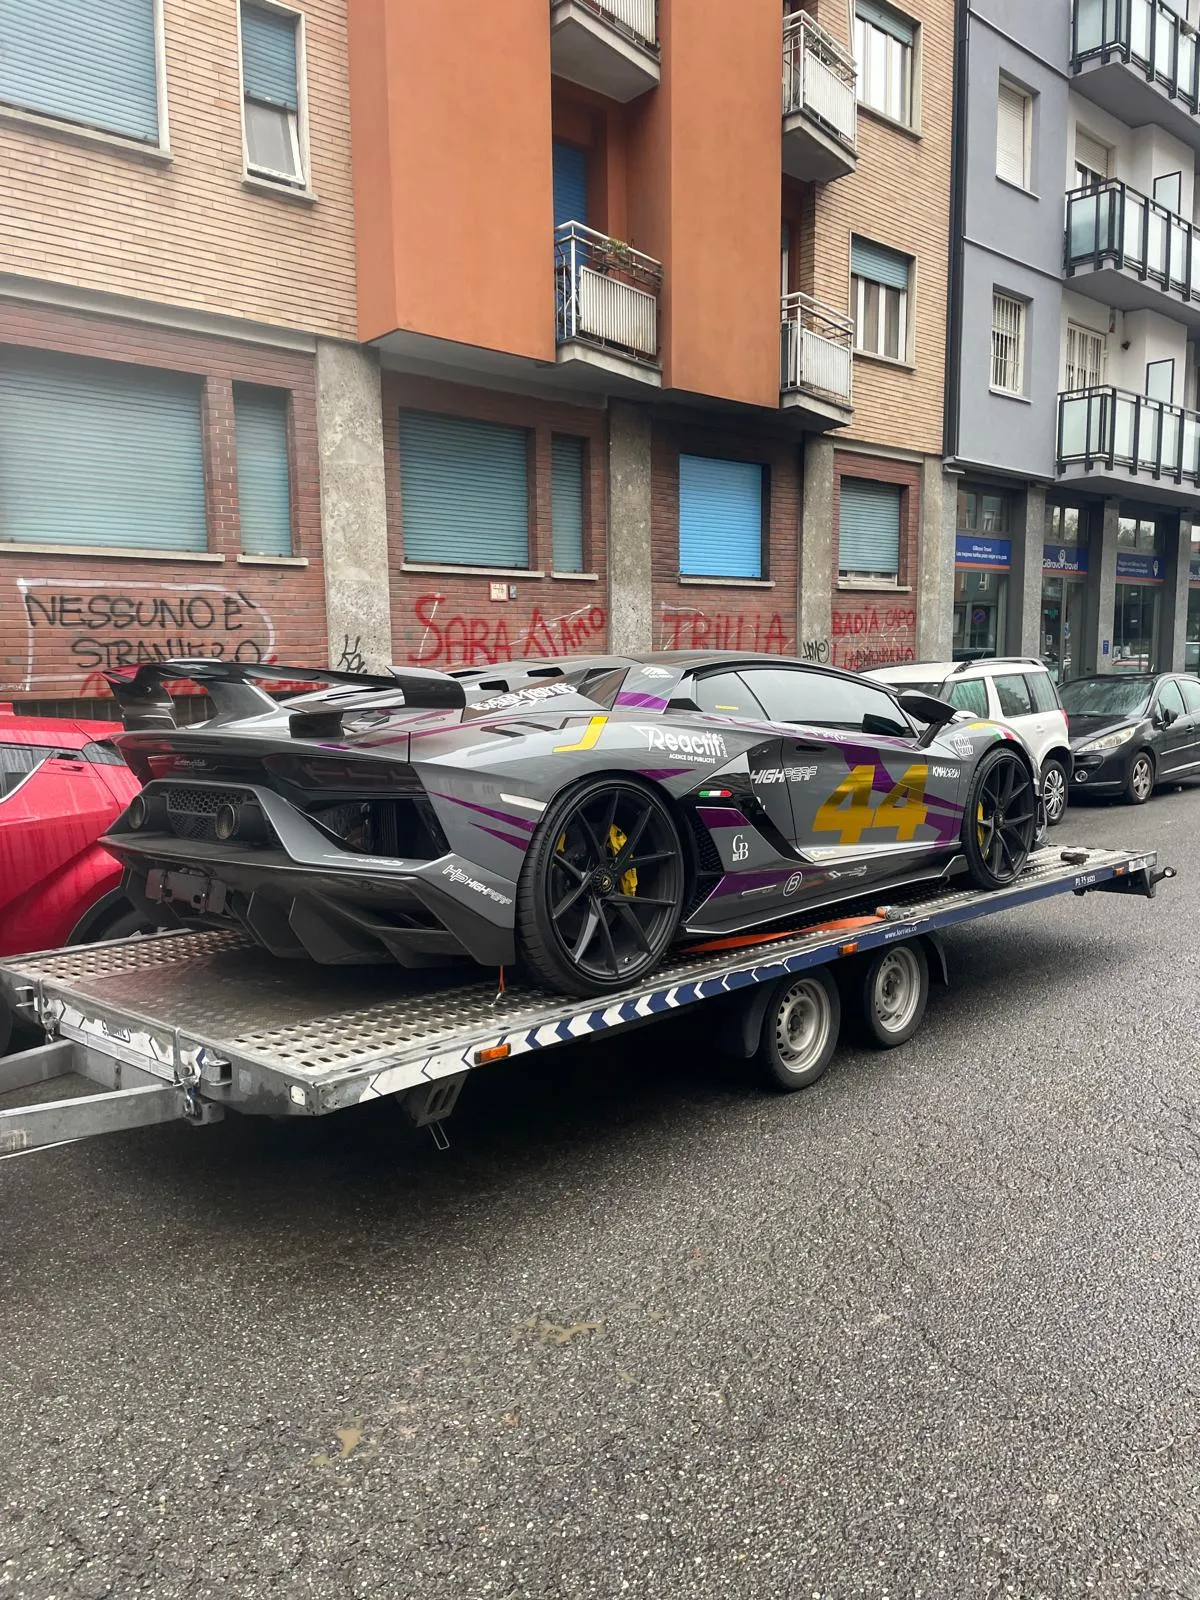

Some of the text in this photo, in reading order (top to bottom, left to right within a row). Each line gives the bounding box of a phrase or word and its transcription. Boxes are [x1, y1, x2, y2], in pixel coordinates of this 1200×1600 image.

[25, 594, 217, 631] NESSUNO
[408, 594, 513, 664] SARA
[632, 724, 721, 757] Reactif
[669, 753, 687, 761] AGENCE
[812, 764, 929, 845] 44
